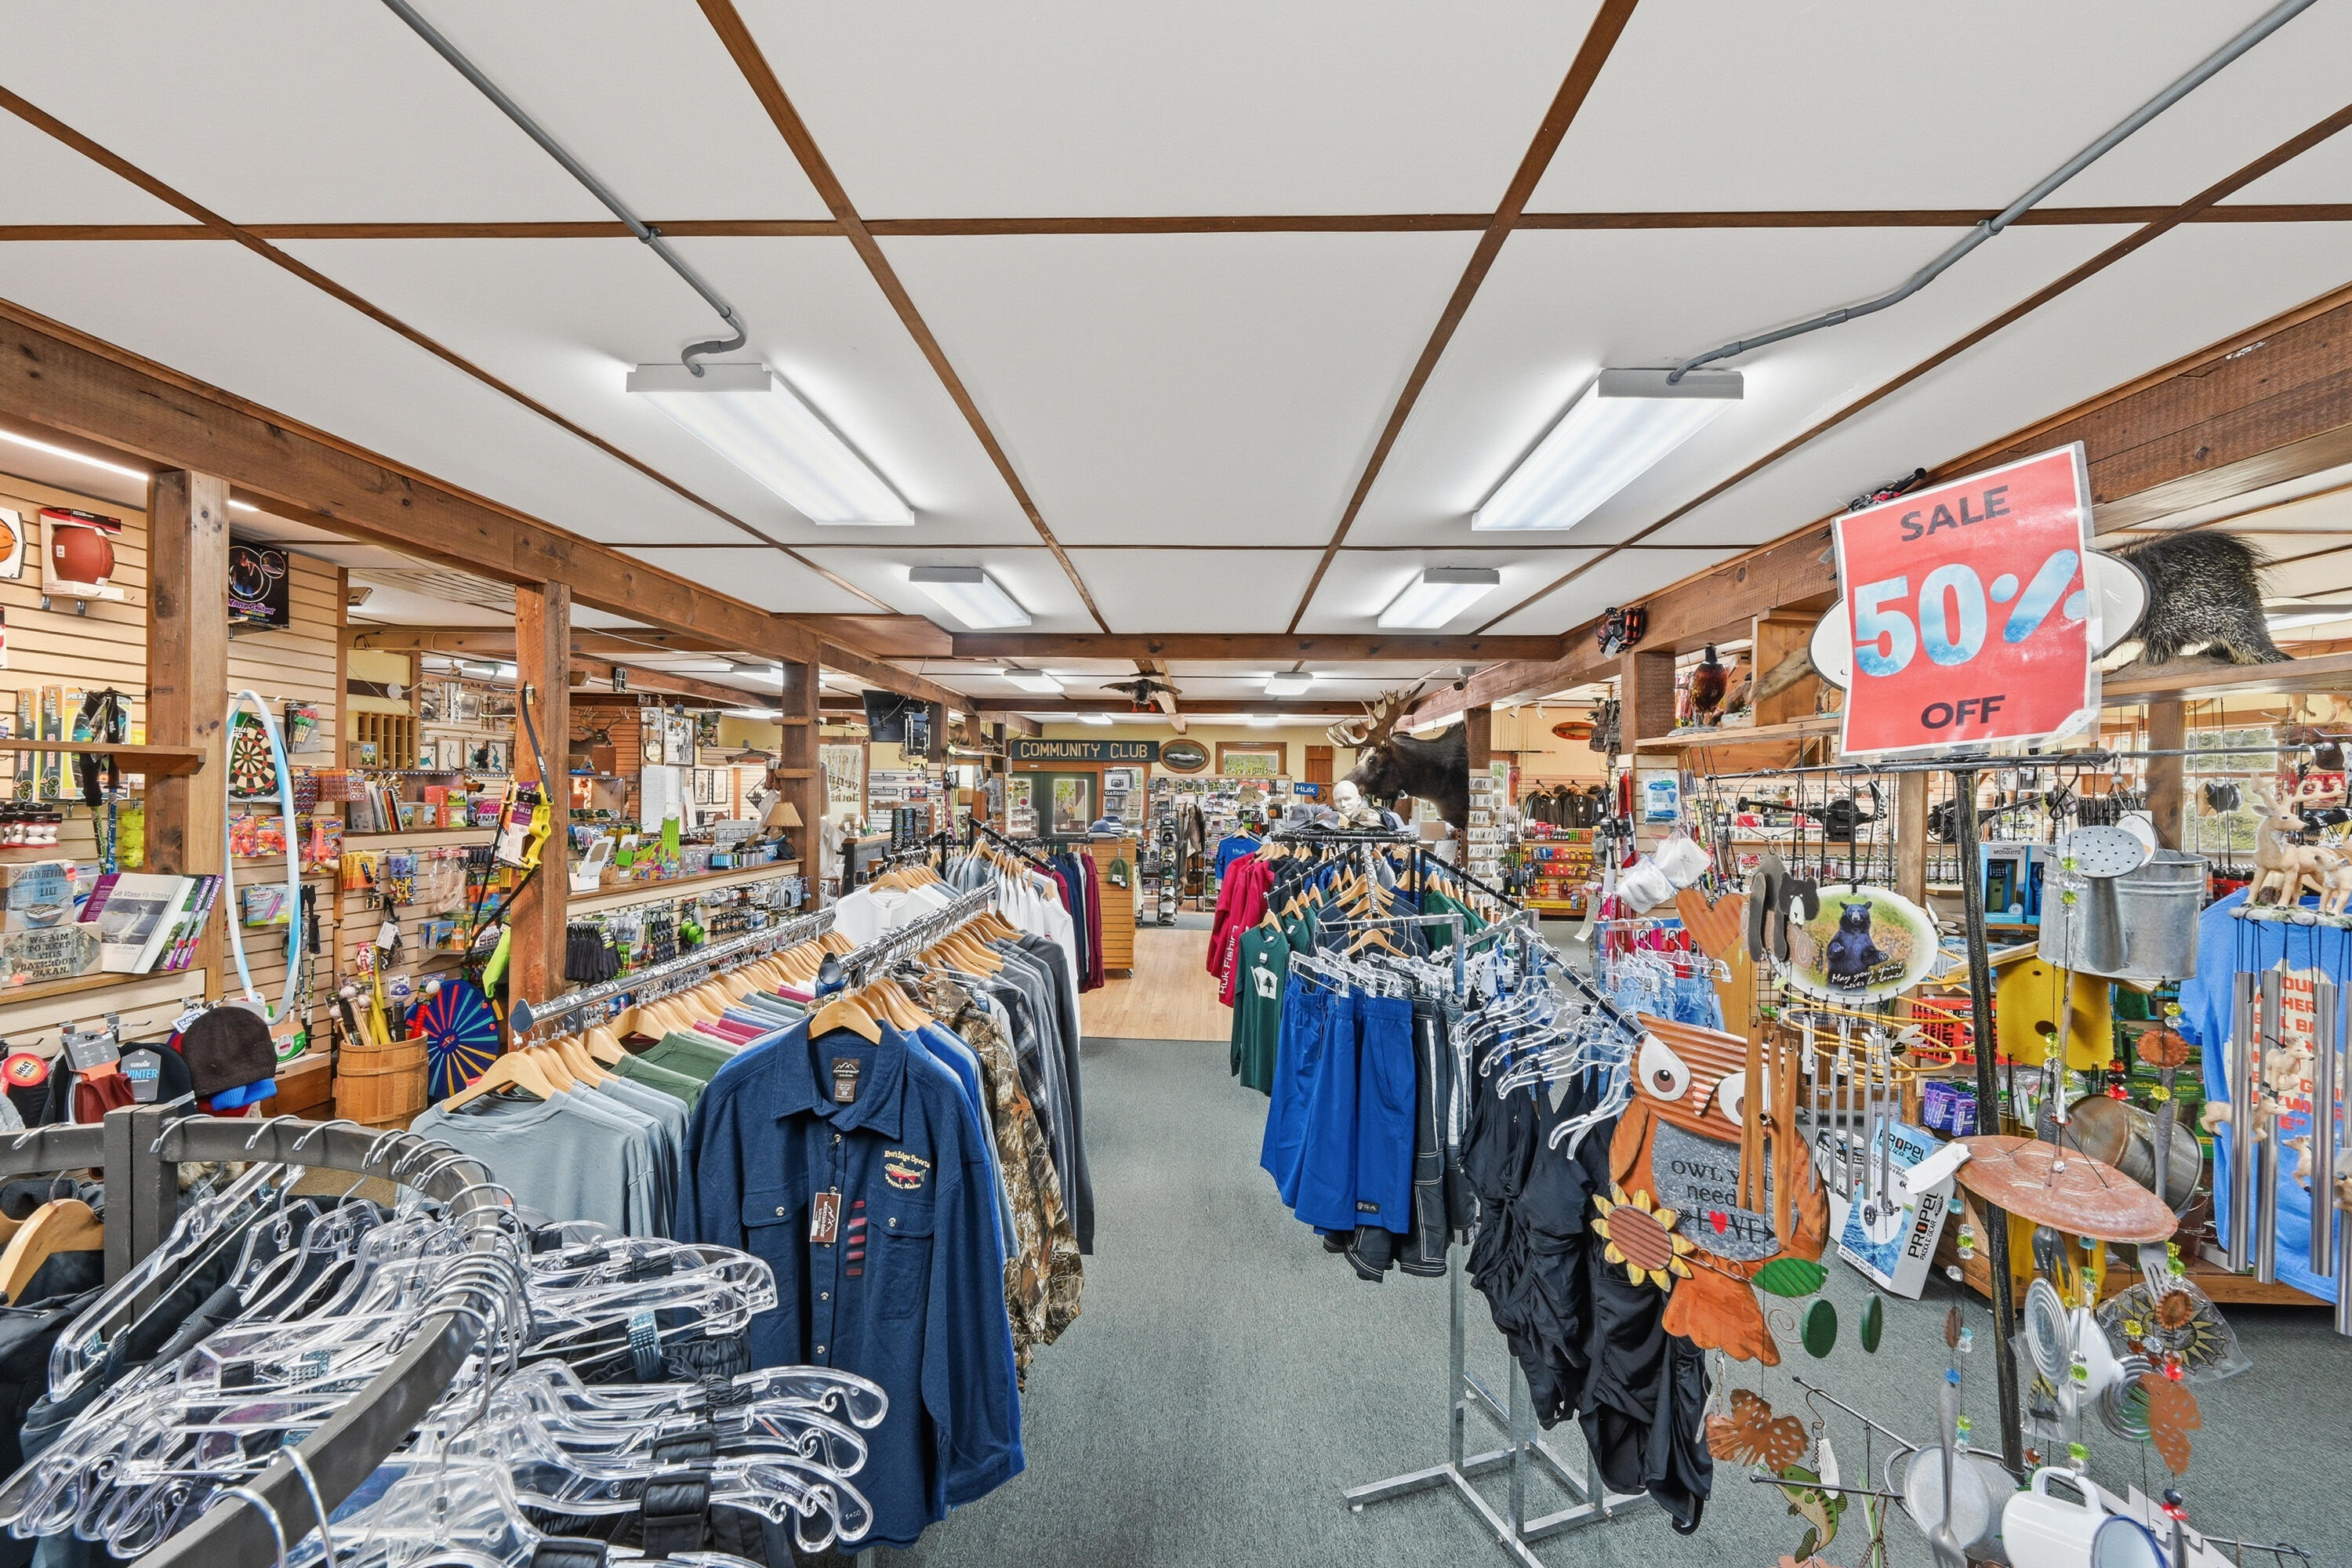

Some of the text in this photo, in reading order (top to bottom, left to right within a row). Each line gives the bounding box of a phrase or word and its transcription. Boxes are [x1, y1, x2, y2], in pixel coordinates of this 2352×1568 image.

[1900, 484, 2012, 543] SALE
[1853, 548, 2089, 677] 50%
[1920, 694, 2006, 729] OFF
[1021, 742, 1148, 759] COMMUNITY CLUB
[27, 942, 72, 953] TO KEEP
[38, 951, 63, 960] THIS
[20, 956, 78, 971] BATHROOM
[32, 967, 70, 978] CLEAN.
[1831, 960, 1903, 984] May your spirit
[1842, 968, 1905, 991] never be tamed
[897, 1150, 911, 1162] Edge
[1671, 1160, 1723, 1183] OWL
[1686, 1184, 1738, 1210] need
[1907, 1192, 1940, 1259] PROPEL
